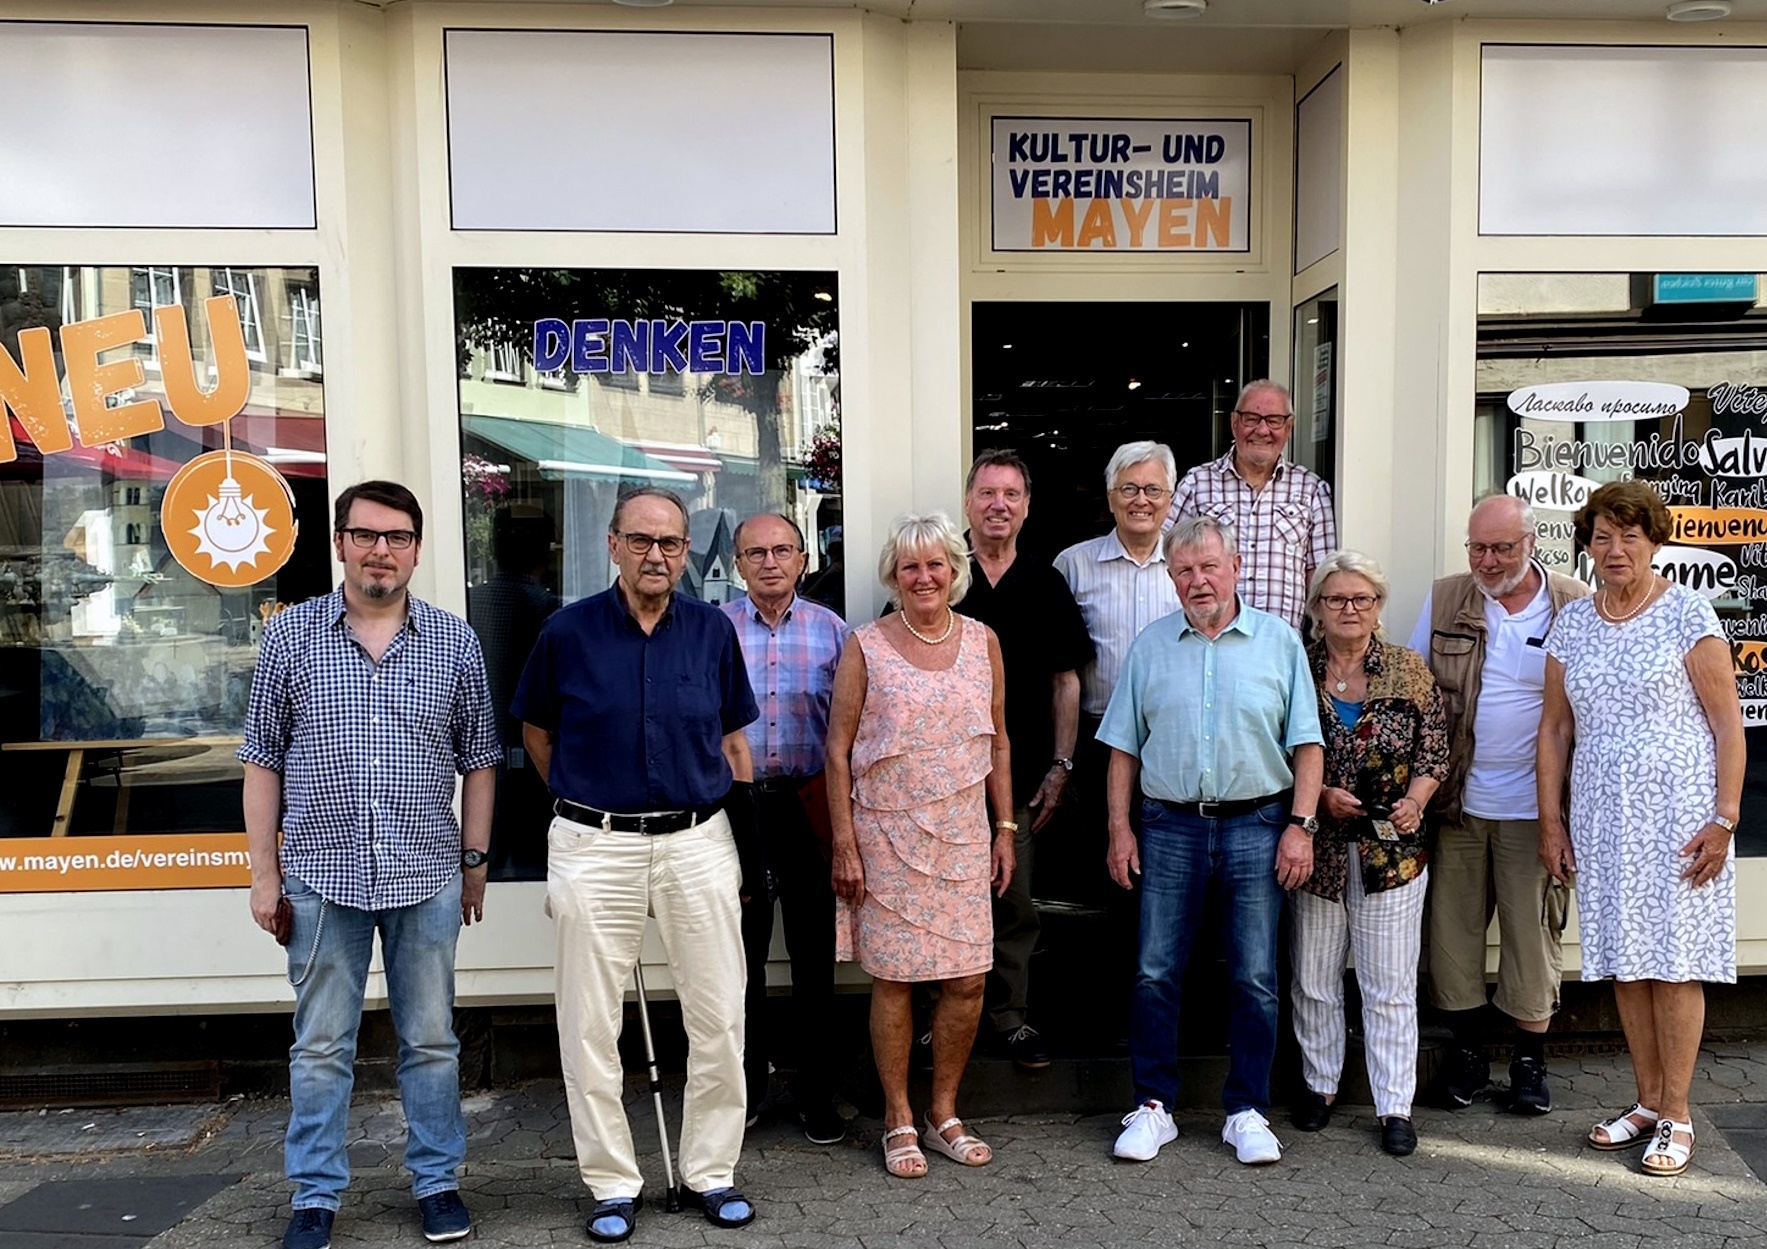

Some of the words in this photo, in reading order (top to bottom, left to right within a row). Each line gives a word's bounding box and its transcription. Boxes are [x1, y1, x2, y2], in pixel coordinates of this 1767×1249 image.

[1009, 133, 1151, 163] KULTUR-
[1162, 134, 1225, 163] UND
[1010, 168, 1219, 199] VEREINSHEIM
[1031, 196, 1232, 248] MAYEN
[533, 318, 765, 375] DENKEN
[0, 294, 250, 463] NEU
[1515, 392, 1593, 413] Ласкаво
[1601, 399, 1677, 418] просимо
[1514, 413, 1700, 474] Bienvenido
[1514, 473, 1592, 505] Welko
[1668, 508, 1767, 538] ienvenu
